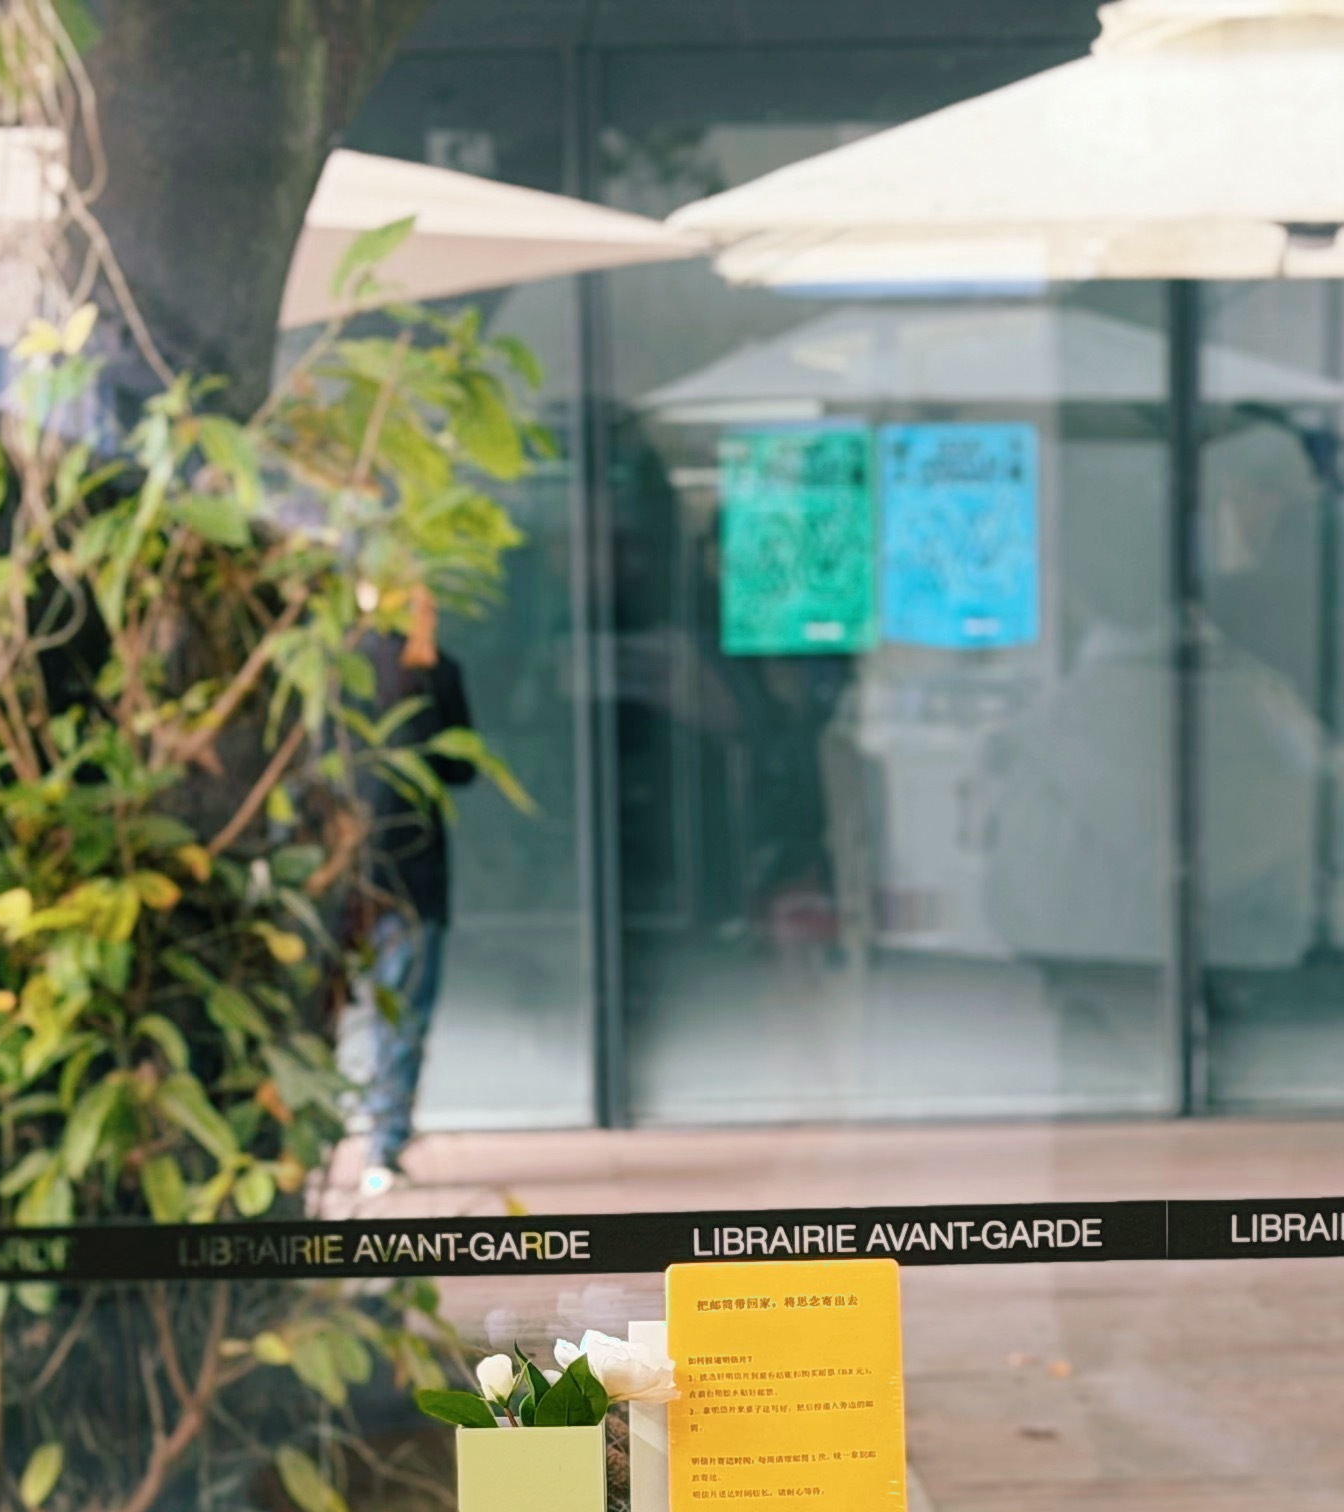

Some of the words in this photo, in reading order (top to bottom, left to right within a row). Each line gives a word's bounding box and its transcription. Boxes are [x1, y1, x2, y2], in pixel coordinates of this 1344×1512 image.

[179, 1234, 344, 1267] LIBRAIRIE
[353, 1230, 591, 1263] AVANT-GARDE
[693, 1223, 857, 1257] LIBRAIRIE
[865, 1218, 1103, 1252] AVANT-GARDE
